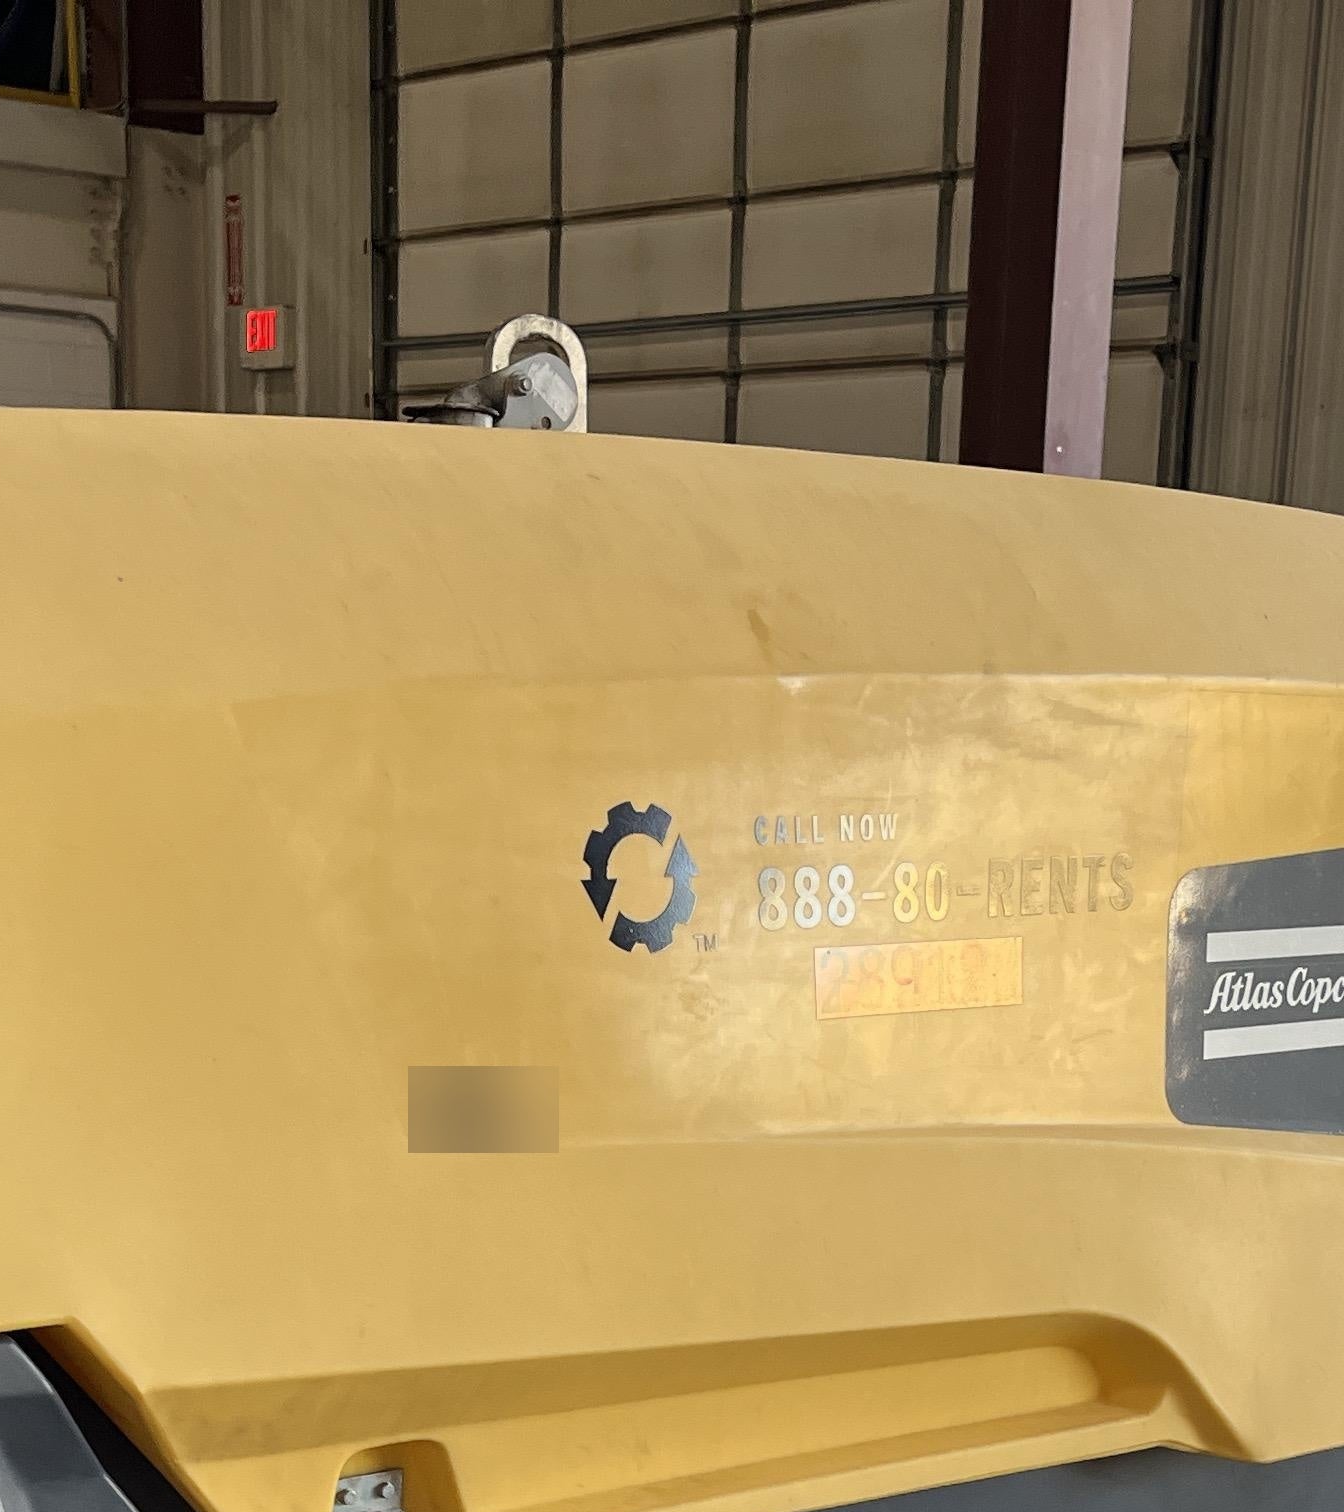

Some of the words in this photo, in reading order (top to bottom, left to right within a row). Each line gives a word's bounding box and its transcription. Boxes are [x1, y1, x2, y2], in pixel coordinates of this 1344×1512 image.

[246, 312, 278, 353] EXIT
[754, 814, 825, 846] CALL
[839, 812, 899, 842] NOW
[757, 851, 1134, 932] 888-80-RENTS
[1203, 971, 1286, 1014] Atlas
